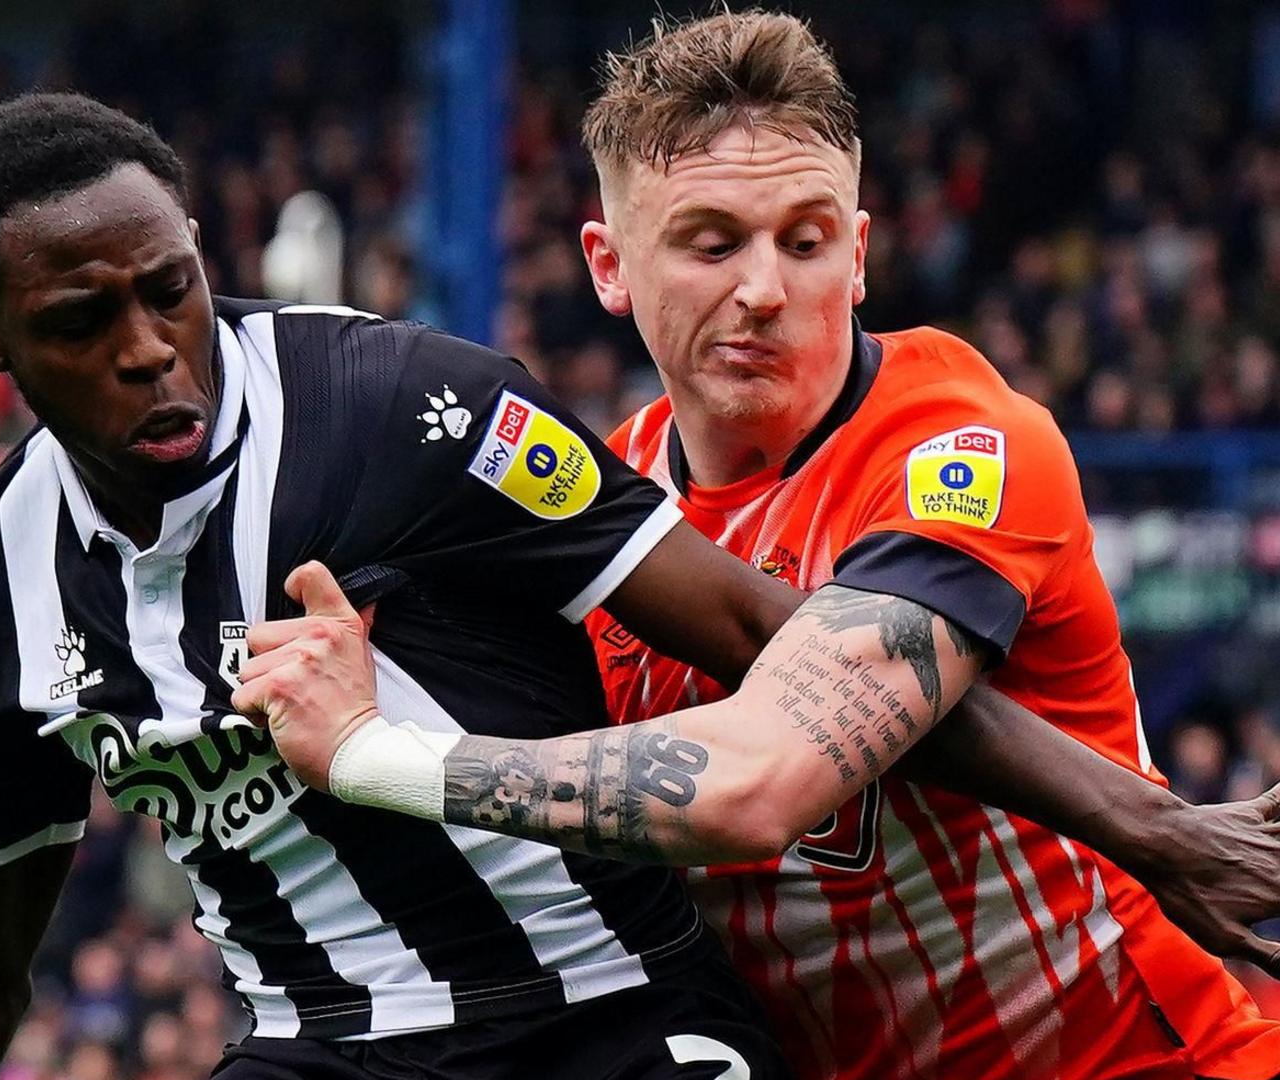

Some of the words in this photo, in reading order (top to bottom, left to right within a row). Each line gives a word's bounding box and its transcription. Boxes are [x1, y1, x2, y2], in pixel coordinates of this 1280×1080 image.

[483, 442, 510, 477] sky
[499, 404, 524, 440] bet
[958, 435, 995, 451] bet
[539, 471, 566, 506] TAKE
[560, 443, 579, 473] TIME
[551, 490, 568, 510] TO
[563, 455, 587, 491] THINK
[921, 492, 954, 505] TAKE
[959, 493, 989, 510] TIME
[924, 503, 942, 514] TO
[946, 503, 986, 521] THINK
[775, 544, 800, 573] TOW
[50, 669, 104, 700] KELME
[829, 643, 862, 675] don't
[880, 689, 901, 712] the
[832, 677, 856, 701] the
[790, 706, 812, 730] my
[831, 705, 854, 732] but
